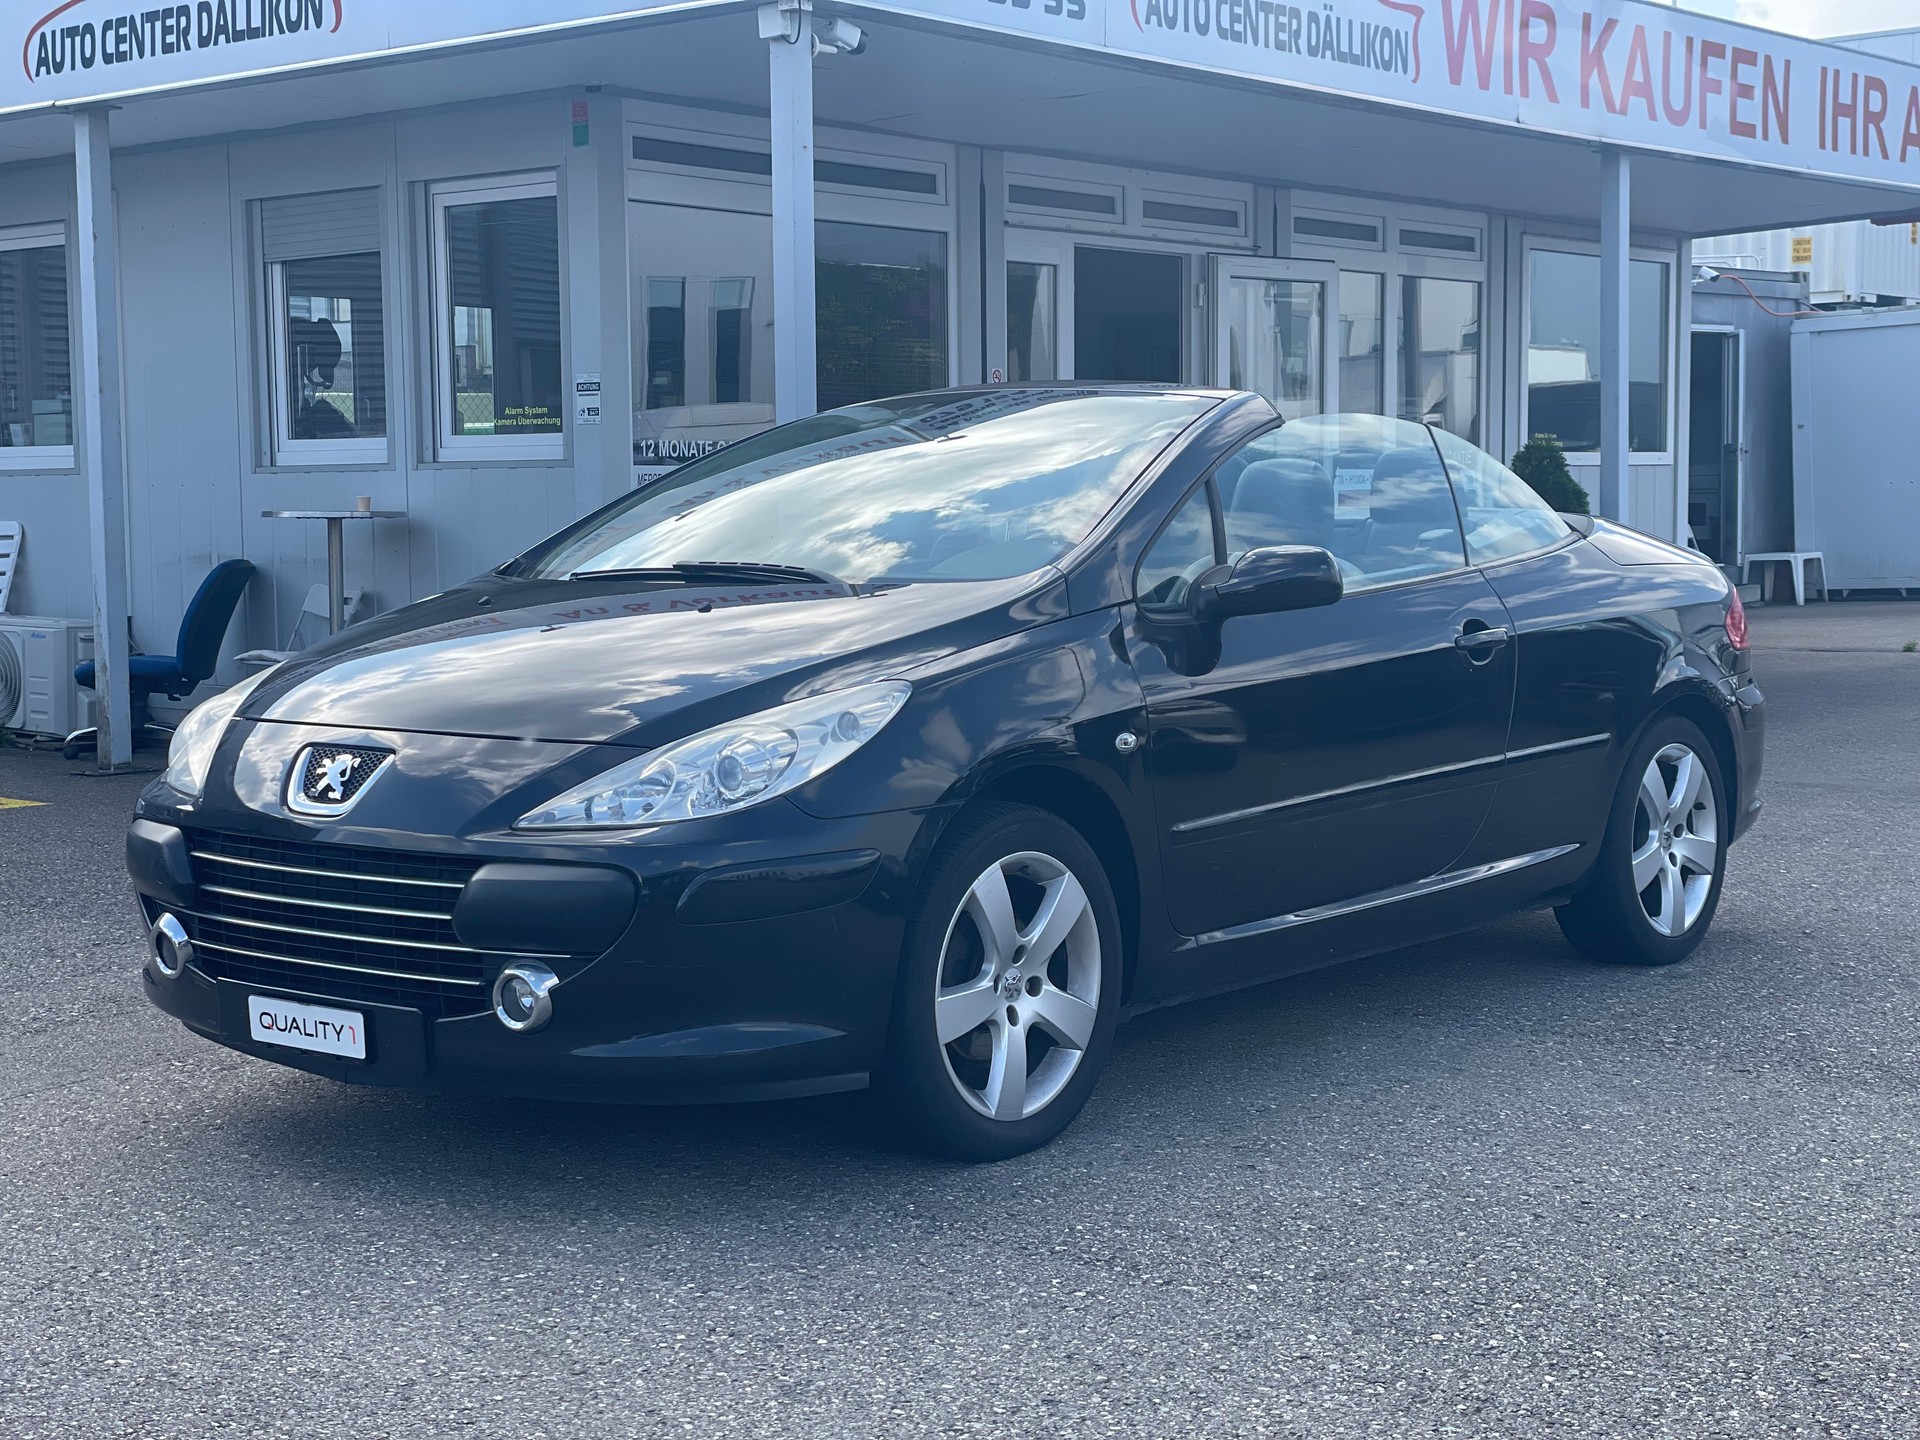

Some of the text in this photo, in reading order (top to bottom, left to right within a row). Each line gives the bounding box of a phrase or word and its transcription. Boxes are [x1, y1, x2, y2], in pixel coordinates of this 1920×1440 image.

[35, 22, 96, 78] AUTO
[101, 4, 191, 65] CENTER
[1144, 0, 1409, 76] AUTO CENTER DÄLLIKON
[1441, 0, 1560, 104] WIR
[1580, 11, 1791, 145] KAUFEN
[1818, 66, 1890, 161] IHR
[494, 415, 561, 426] Kamera Überwachung
[504, 406, 548, 416] Alarm System
[640, 440, 655, 457] 12
[659, 440, 713, 458] MONATE
